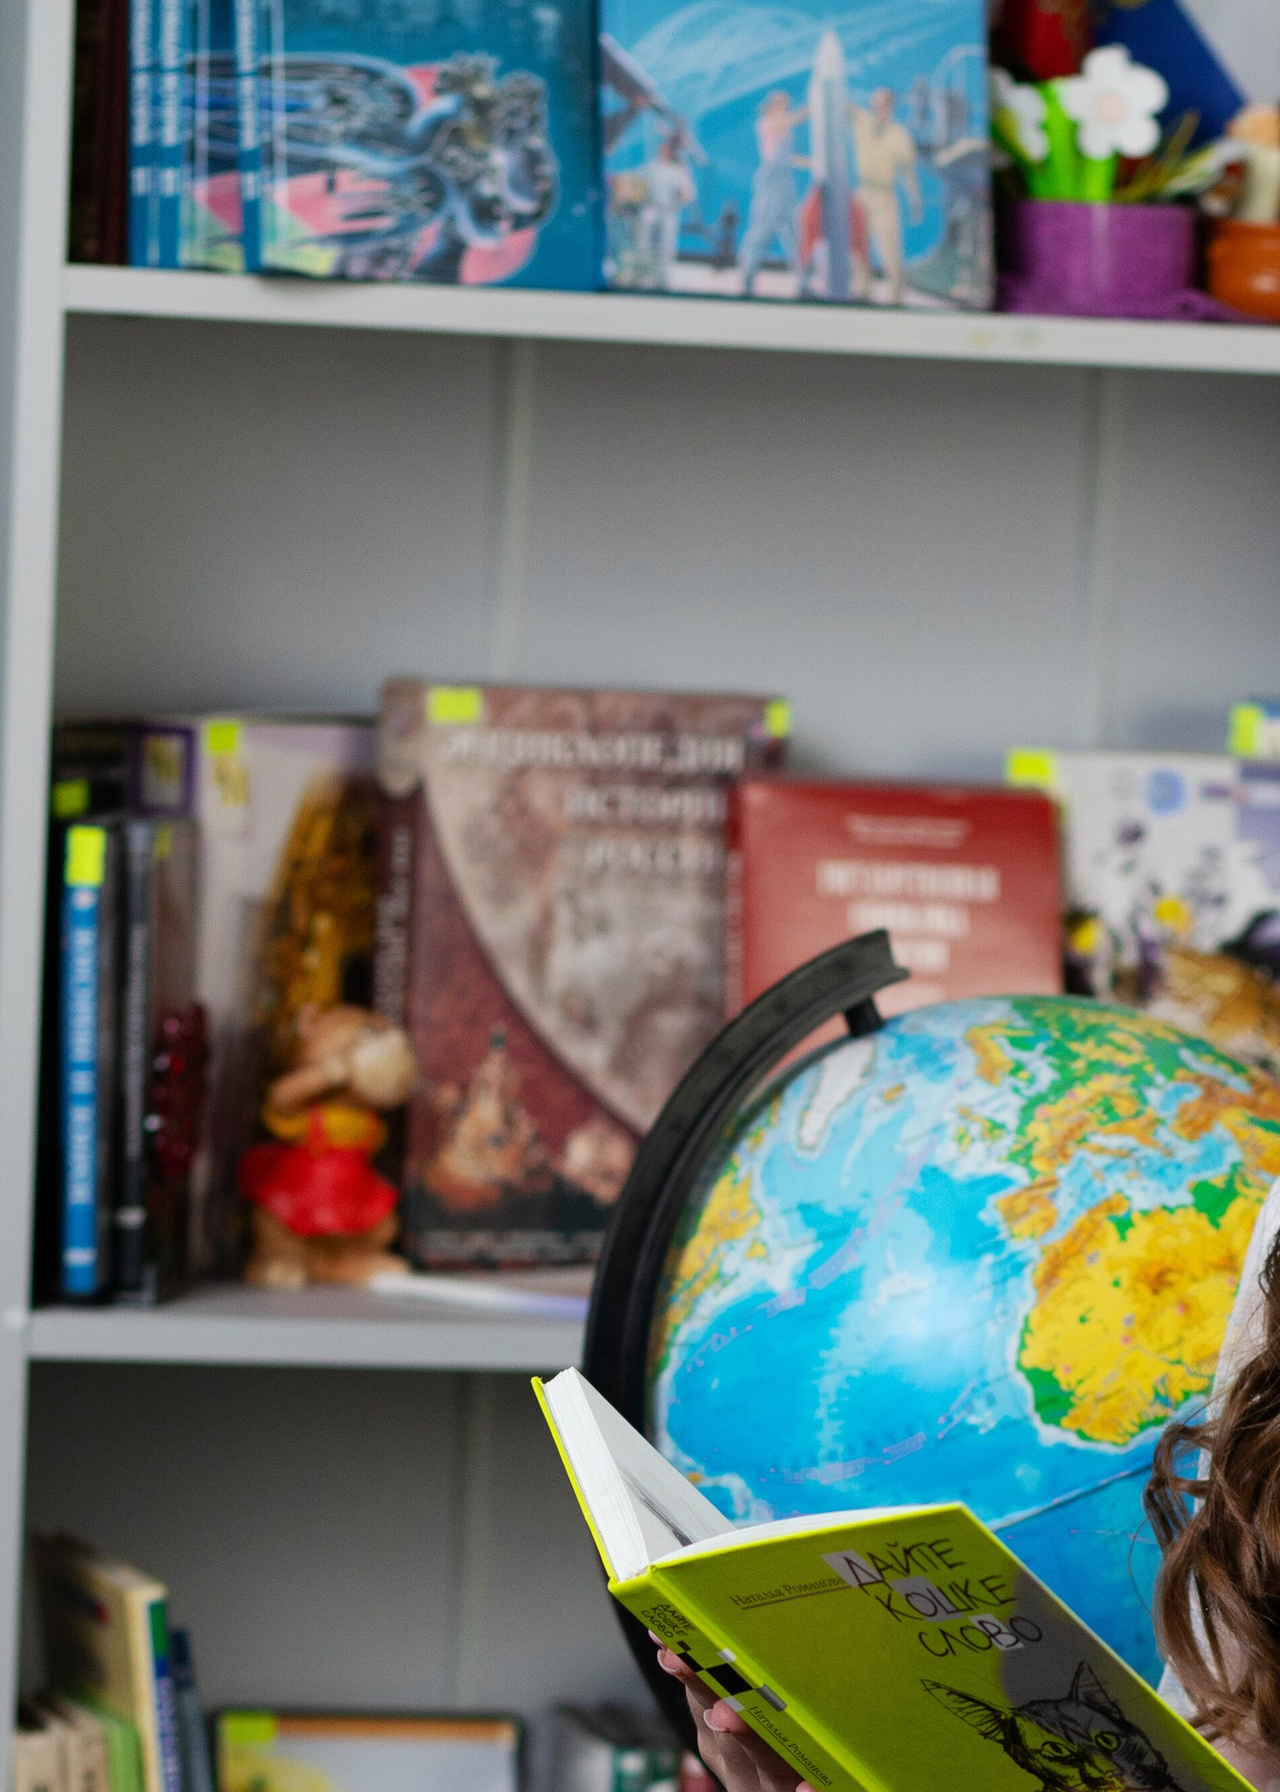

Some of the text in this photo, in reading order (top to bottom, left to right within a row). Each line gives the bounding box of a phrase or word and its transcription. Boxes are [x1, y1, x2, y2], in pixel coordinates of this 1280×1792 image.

[844, 1539, 966, 1597] ДАЙТЕ
[730, 1577, 847, 1606] Наталья Романова
[875, 1575, 1016, 1622] КОШКЕ
[641, 1609, 674, 1638] СЛОВО
[651, 1605, 688, 1637] КОШКЕ
[657, 1604, 696, 1631] ДАЙТЕ
[918, 1616, 1042, 1657] СЛОВО
[749, 1705, 834, 1787] Наталья Романова
